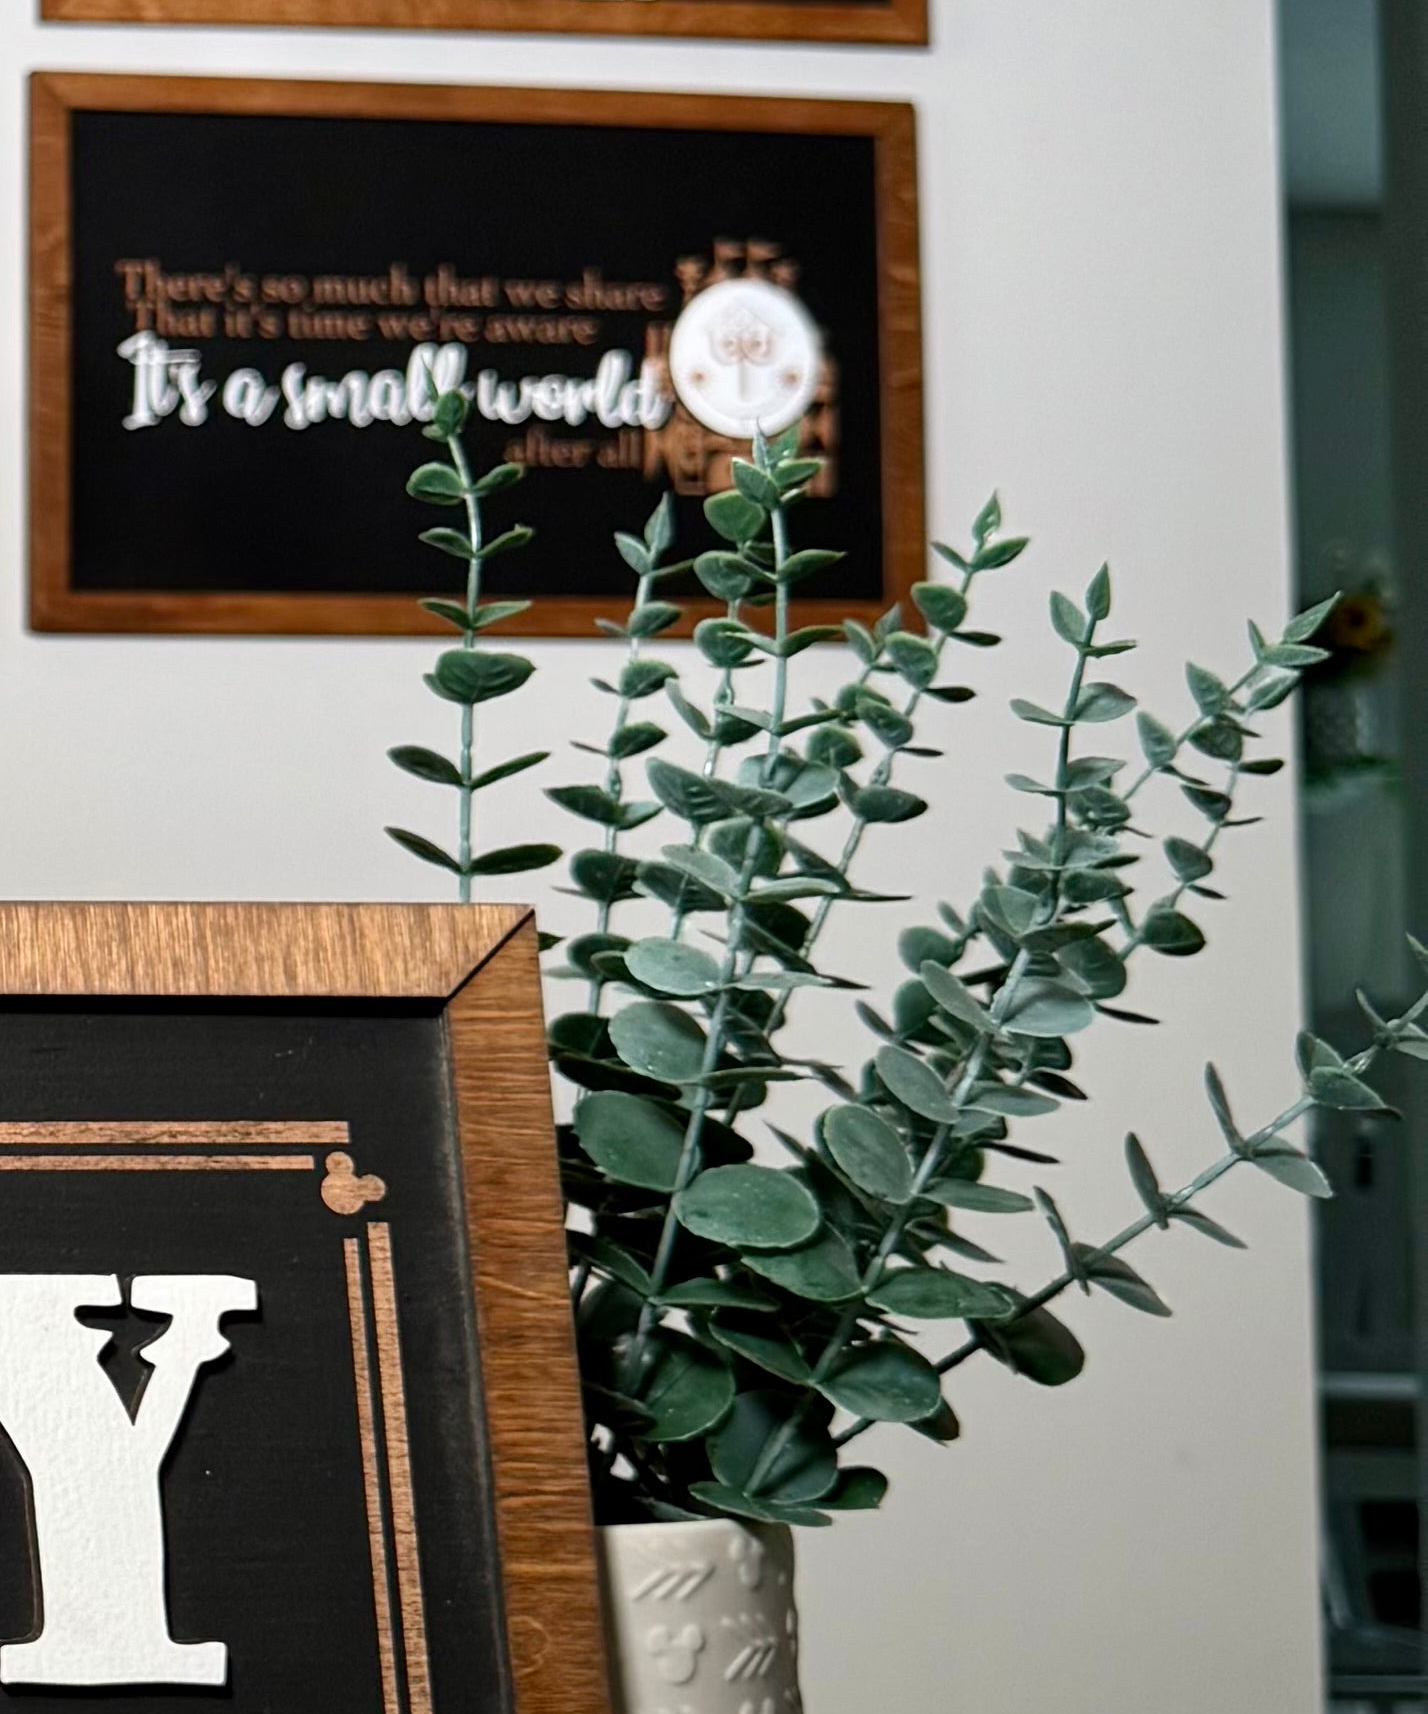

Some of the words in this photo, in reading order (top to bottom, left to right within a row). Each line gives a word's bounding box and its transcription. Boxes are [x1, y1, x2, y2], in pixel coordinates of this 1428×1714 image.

[260, 273, 310, 304] so
[311, 261, 421, 306] much
[423, 262, 500, 309] that
[504, 279, 564, 309] we
[563, 266, 670, 312] share
[484, 313, 598, 345] aware
[222, 367, 280, 427] a
[281, 341, 476, 431] small
[475, 348, 675, 431] world
